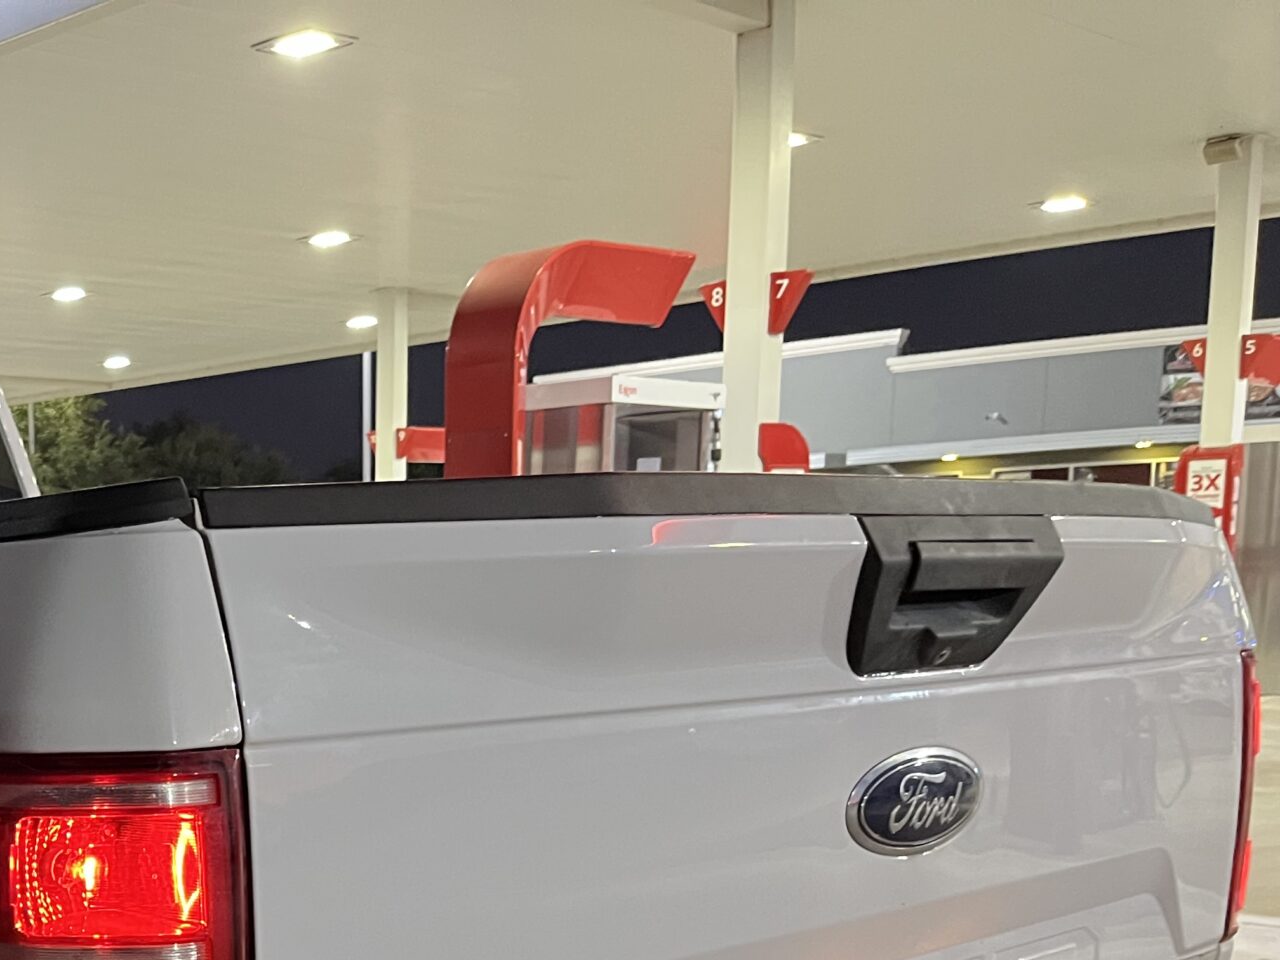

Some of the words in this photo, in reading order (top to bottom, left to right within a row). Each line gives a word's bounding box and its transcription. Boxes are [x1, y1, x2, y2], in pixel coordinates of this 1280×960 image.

[711, 287, 723, 307] 8
[775, 278, 789, 299] 7
[1192, 342, 1204, 358] 6
[1244, 339, 1257, 355] 5
[1191, 473, 1222, 492] 3X
[888, 771, 963, 835] Ford
